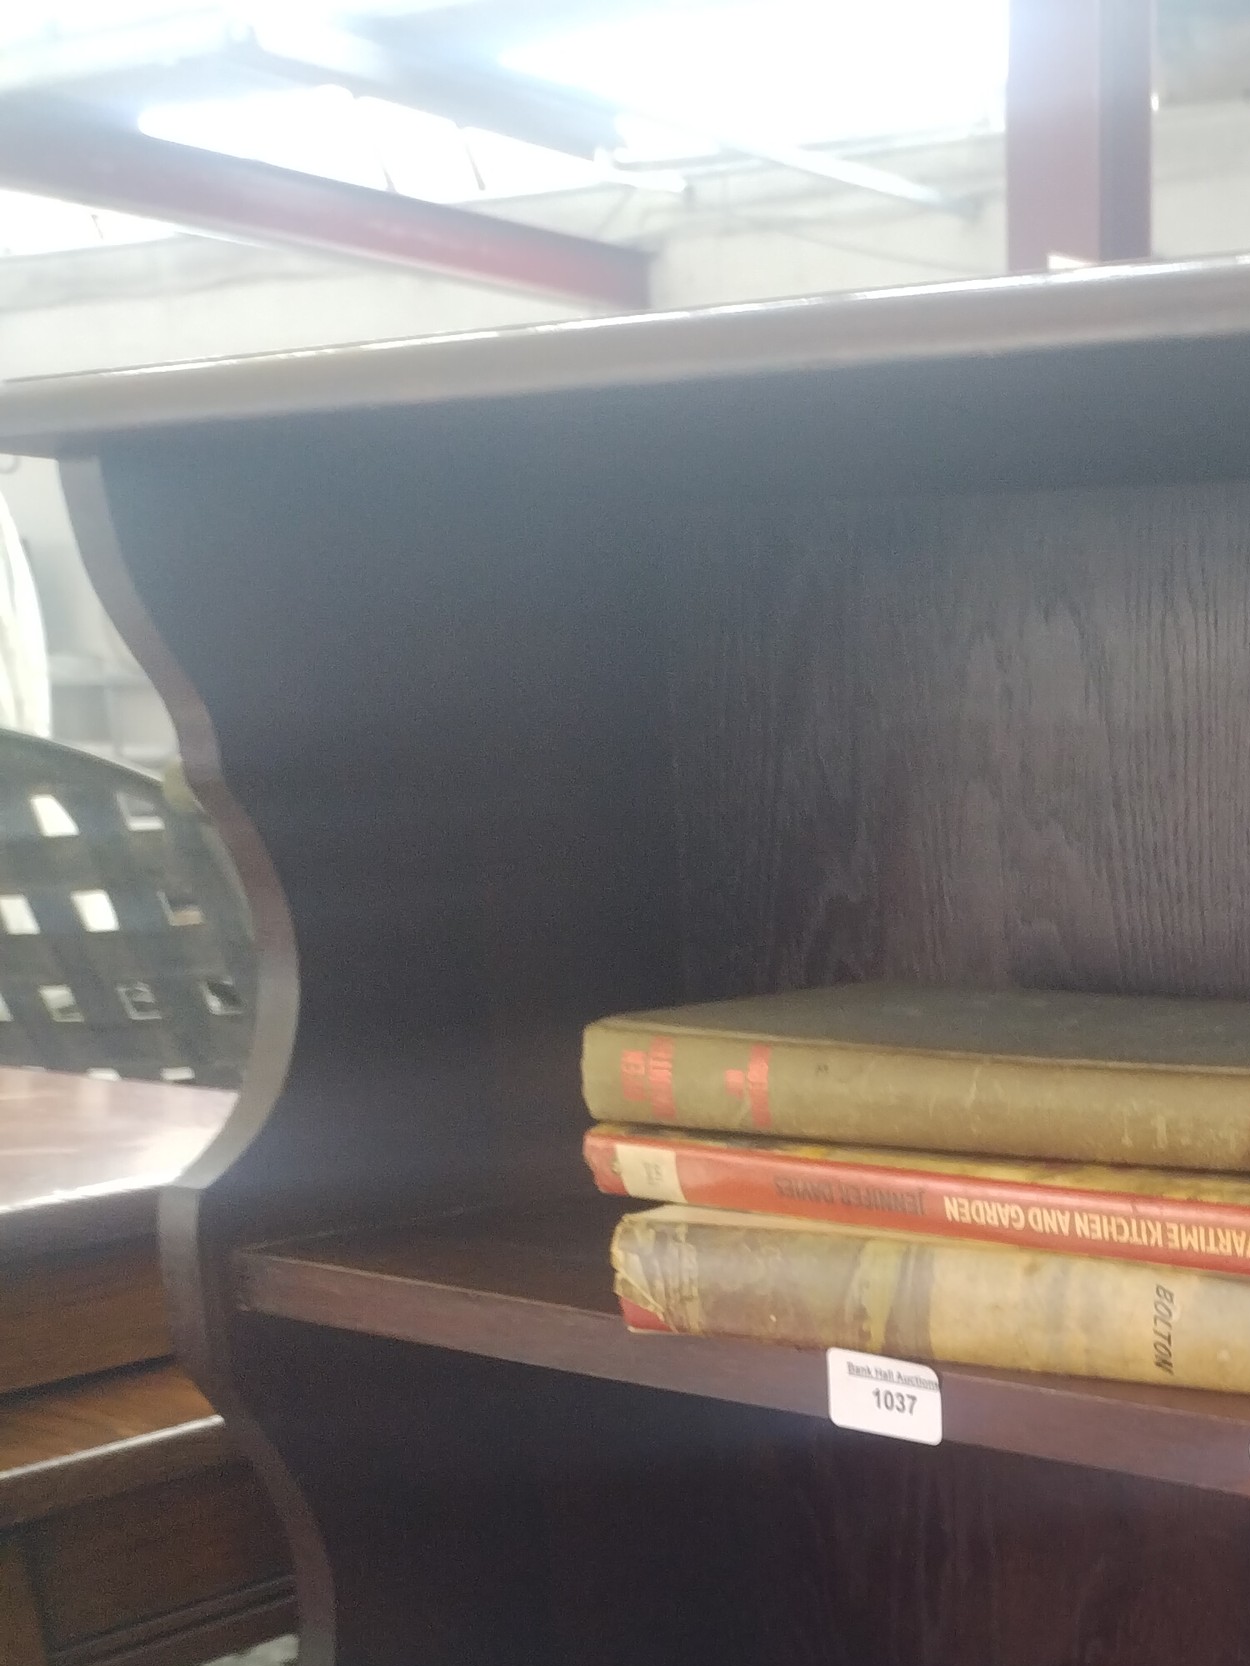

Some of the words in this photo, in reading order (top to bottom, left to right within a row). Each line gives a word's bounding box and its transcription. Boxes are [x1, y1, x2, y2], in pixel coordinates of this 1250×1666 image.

[772, 1173, 838, 1205] DAVIES
[840, 1182, 926, 1217] JENNIFER
[943, 1195, 1025, 1231] GARDEN
[1027, 1208, 1071, 1236] AND
[1074, 1210, 1163, 1248] KITCHEN
[1152, 1283, 1175, 1376] BOLTON
[847, 1361, 872, 1379] Bank
[874, 1367, 894, 1383] Hall
[872, 1387, 917, 1416] 1037
